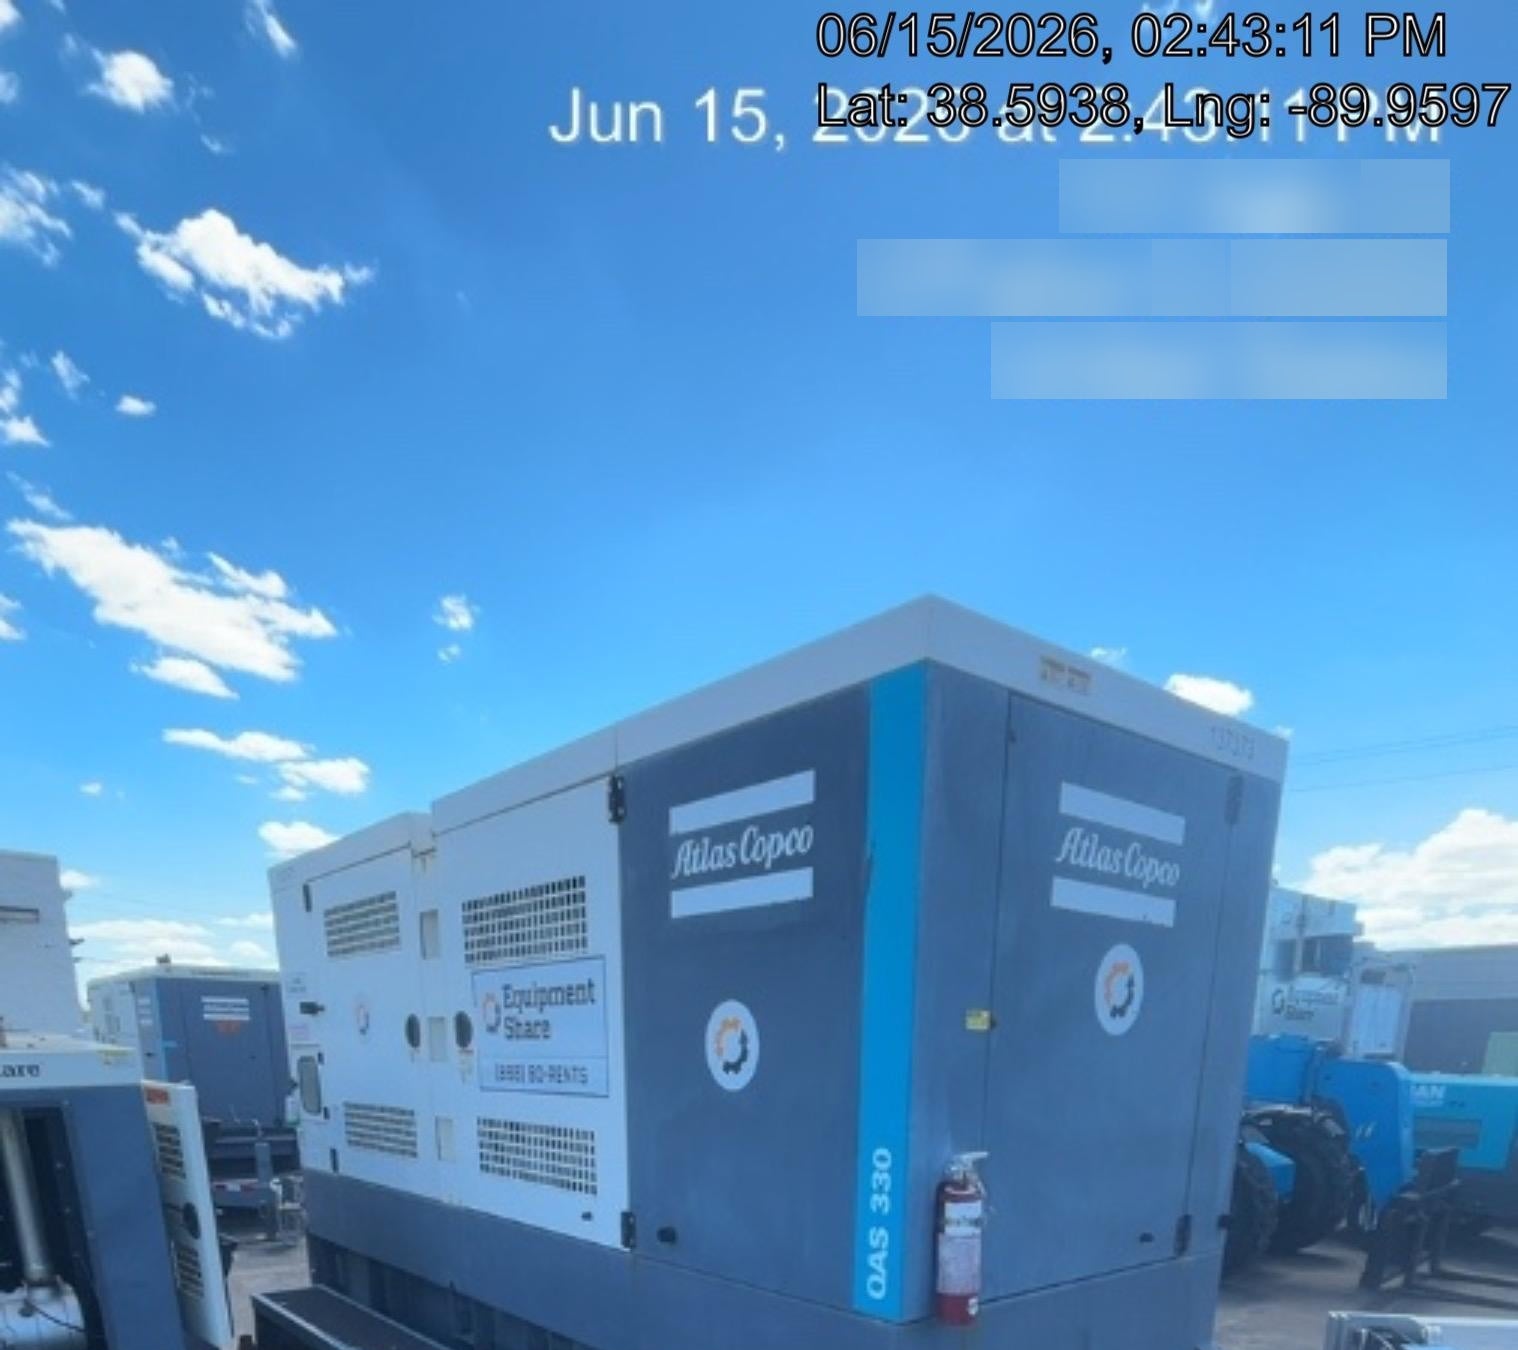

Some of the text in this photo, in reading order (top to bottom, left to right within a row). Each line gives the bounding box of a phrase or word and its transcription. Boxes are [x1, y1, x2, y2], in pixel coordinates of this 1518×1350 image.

[670, 824, 814, 880] Atlas Copco
[1056, 827, 1181, 889] Atlas Copco
[501, 977, 596, 1014] Equipment
[503, 1016, 552, 1041] Share
[0, 1063, 40, 1078] are
[869, 1147, 892, 1216] 330
